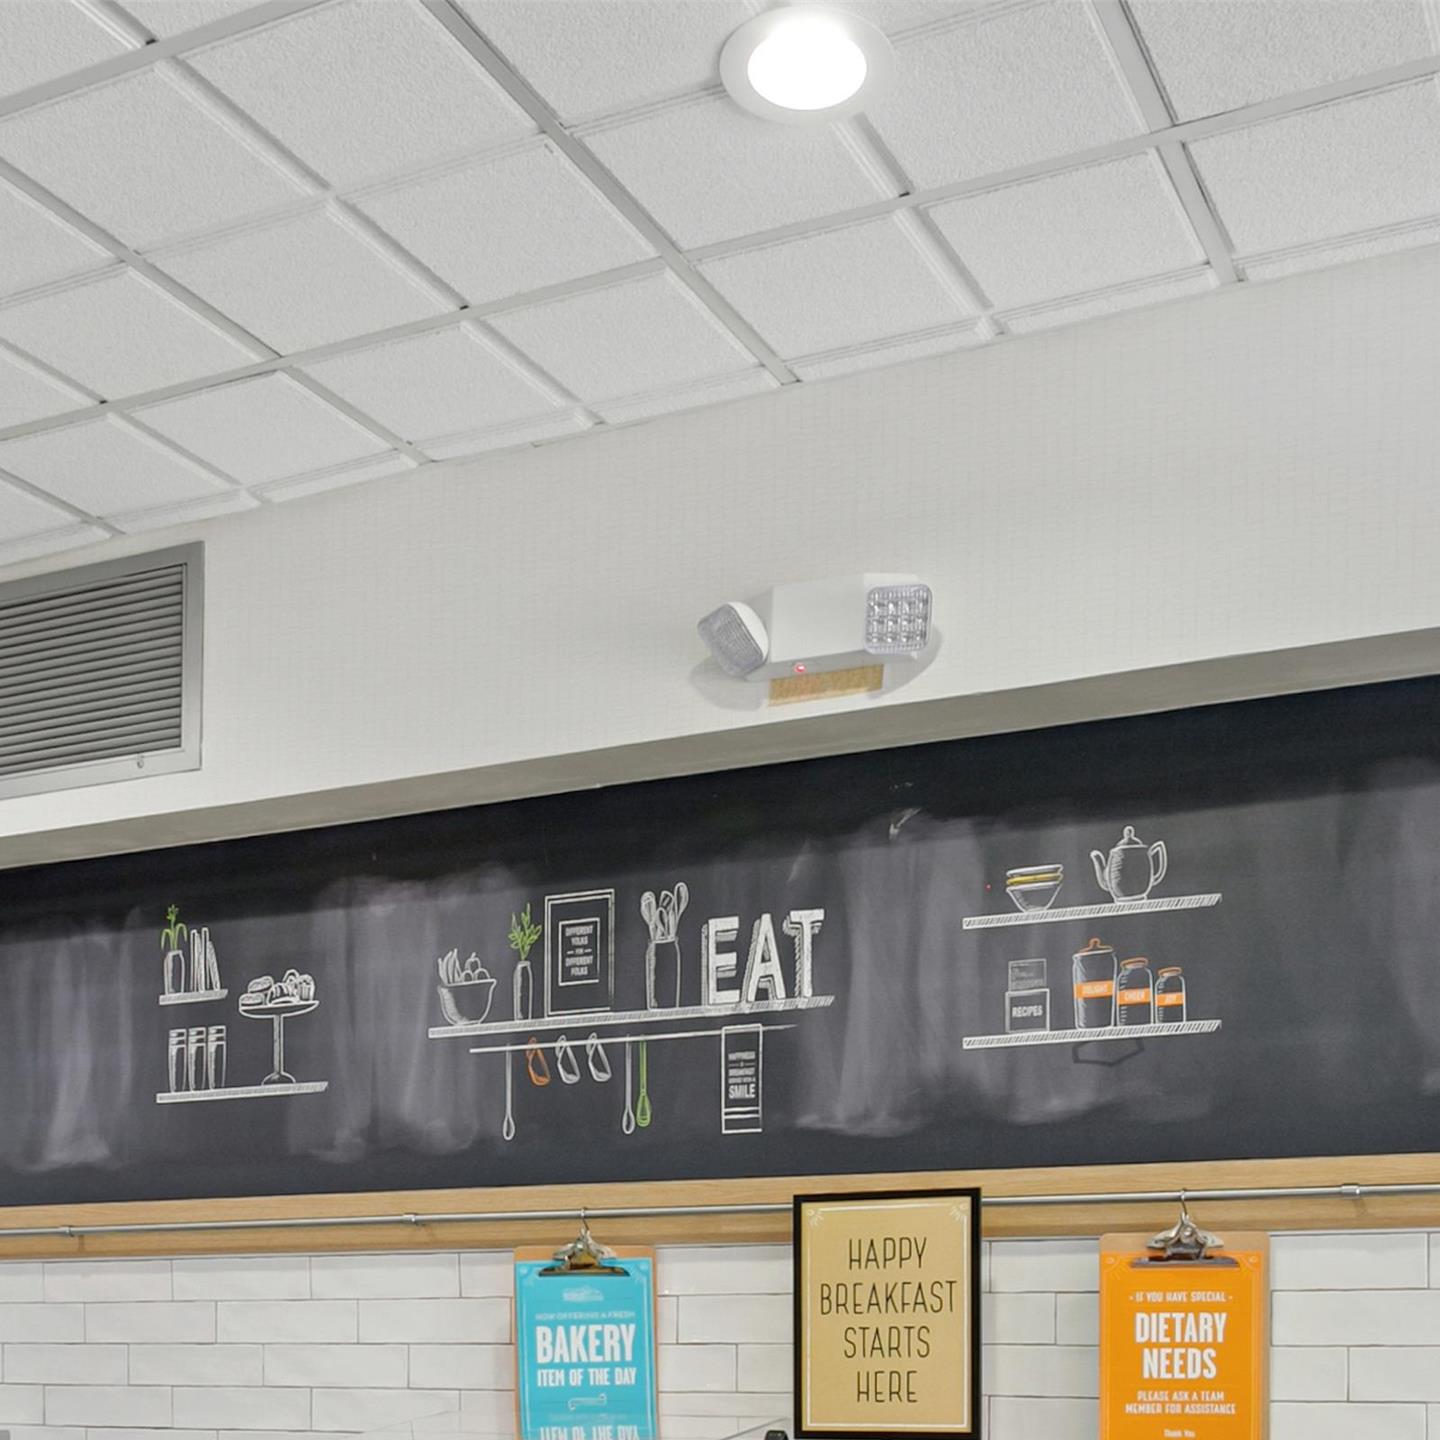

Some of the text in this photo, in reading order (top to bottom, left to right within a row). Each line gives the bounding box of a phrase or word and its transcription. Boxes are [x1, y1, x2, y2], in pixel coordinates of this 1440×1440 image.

[701, 908, 825, 1005] EAT
[1012, 1005, 1043, 1017] RECIPES
[728, 1083, 756, 1099] SMILE
[848, 1236, 927, 1270] HAPPY
[820, 1280, 957, 1315] BREAKFAST
[1136, 1291, 1226, 1303] IF YOU HAVE SPECIAL
[844, 1325, 930, 1359] STARTS
[1135, 1312, 1227, 1343] DIETARY
[536, 1324, 636, 1364] BAKERY
[537, 1367, 637, 1387] ITEM OF THE DAY
[1142, 1348, 1217, 1379] NEEDS
[857, 1370, 918, 1403] HERE
[1137, 1391, 1224, 1401] PLEASE ASK A TEAM
[1125, 1403, 1236, 1415] MEMBER FOR ASSISTANCE
